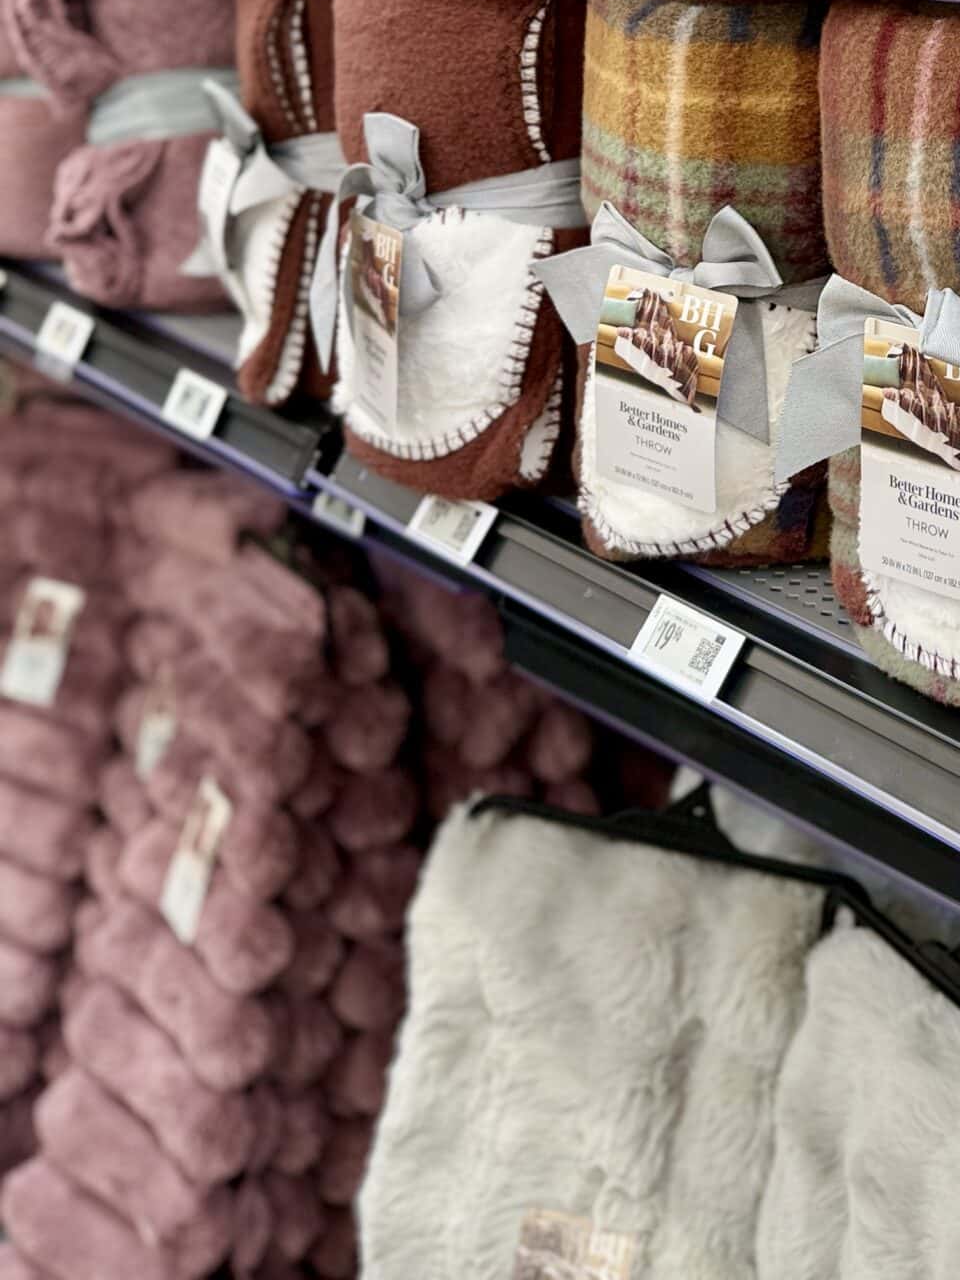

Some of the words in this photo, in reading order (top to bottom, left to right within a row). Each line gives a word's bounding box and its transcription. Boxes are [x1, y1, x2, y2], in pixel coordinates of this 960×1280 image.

[679, 294, 723, 332] BH
[693, 328, 717, 358] G
[619, 400, 651, 421] Better
[650, 411, 688, 433] Homes
[627, 415, 636, 427] &
[636, 418, 681, 442] Gardens
[635, 434, 672, 456] THROW
[889, 474, 925, 497] Better
[897, 490, 908, 506] &
[907, 494, 960, 521] Gardens
[905, 516, 949, 539] THROW
